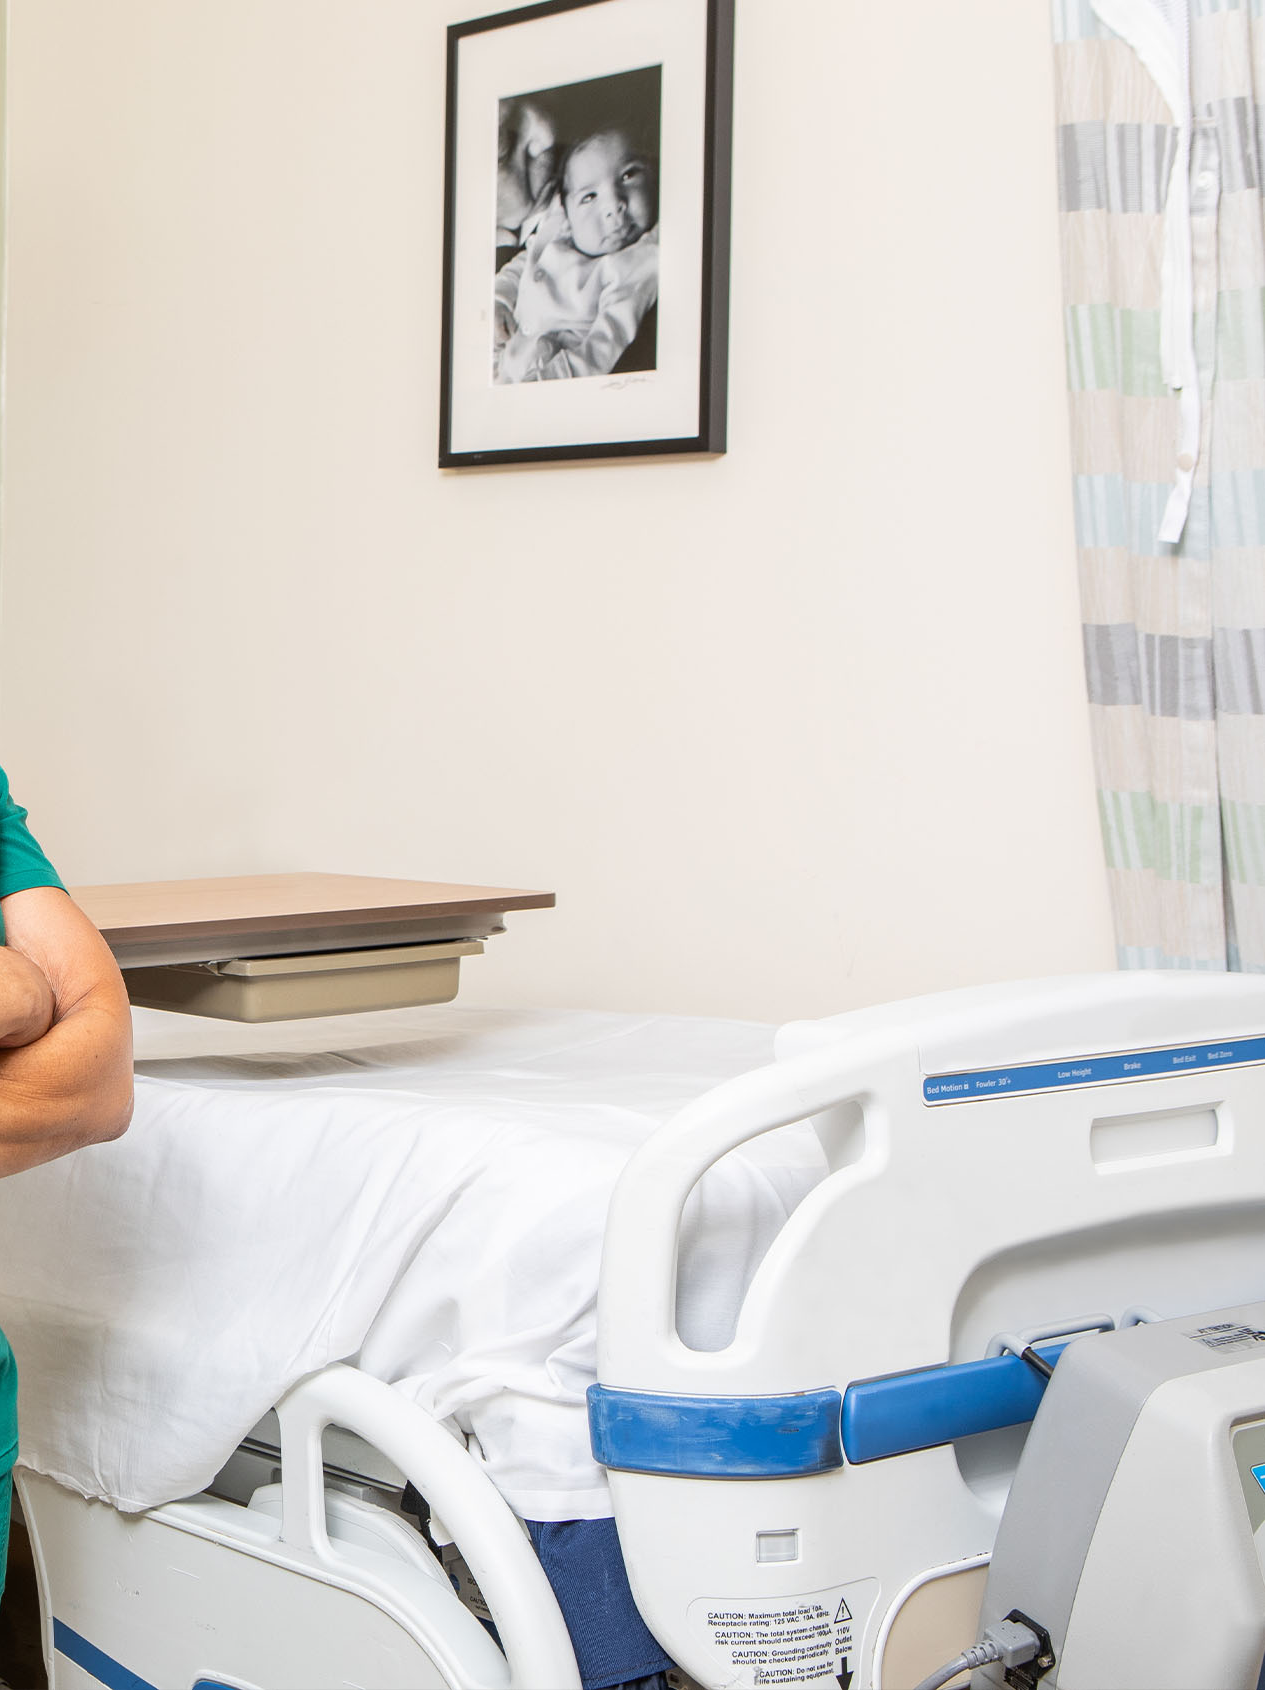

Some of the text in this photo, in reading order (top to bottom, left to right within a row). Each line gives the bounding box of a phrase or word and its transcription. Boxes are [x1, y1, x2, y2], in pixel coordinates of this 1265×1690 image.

[1123, 1061, 1141, 1071] Brake
[1057, 1067, 1092, 1079] Low Height
[926, 1083, 963, 1095] Bed Motion
[976, 1080, 997, 1089] Fowler
[748, 1611, 782, 1620] Maximum
[782, 1609, 797, 1617] total
[797, 1606, 811, 1615] load
[749, 1619, 772, 1627] rating:
[715, 1631, 754, 1639] CAUTION:
[770, 1630, 785, 1638] total
[786, 1627, 808, 1637] system
[808, 1622, 830, 1632] chassis
[836, 1625, 851, 1636] 110V
[758, 1637, 782, 1646] should
[794, 1632, 815, 1641] exceed
[834, 1635, 853, 1646] Outlet
[731, 1641, 833, 1658] CAUTION: Grounding continuity
[834, 1645, 853, 1656] Below
[768, 1655, 796, 1664] checked
[759, 1668, 795, 1678] CAUTION:
[796, 1667, 806, 1675] Do
[826, 1660, 834, 1668] for
[759, 1677, 771, 1685] life
[771, 1674, 806, 1684] sustaining
